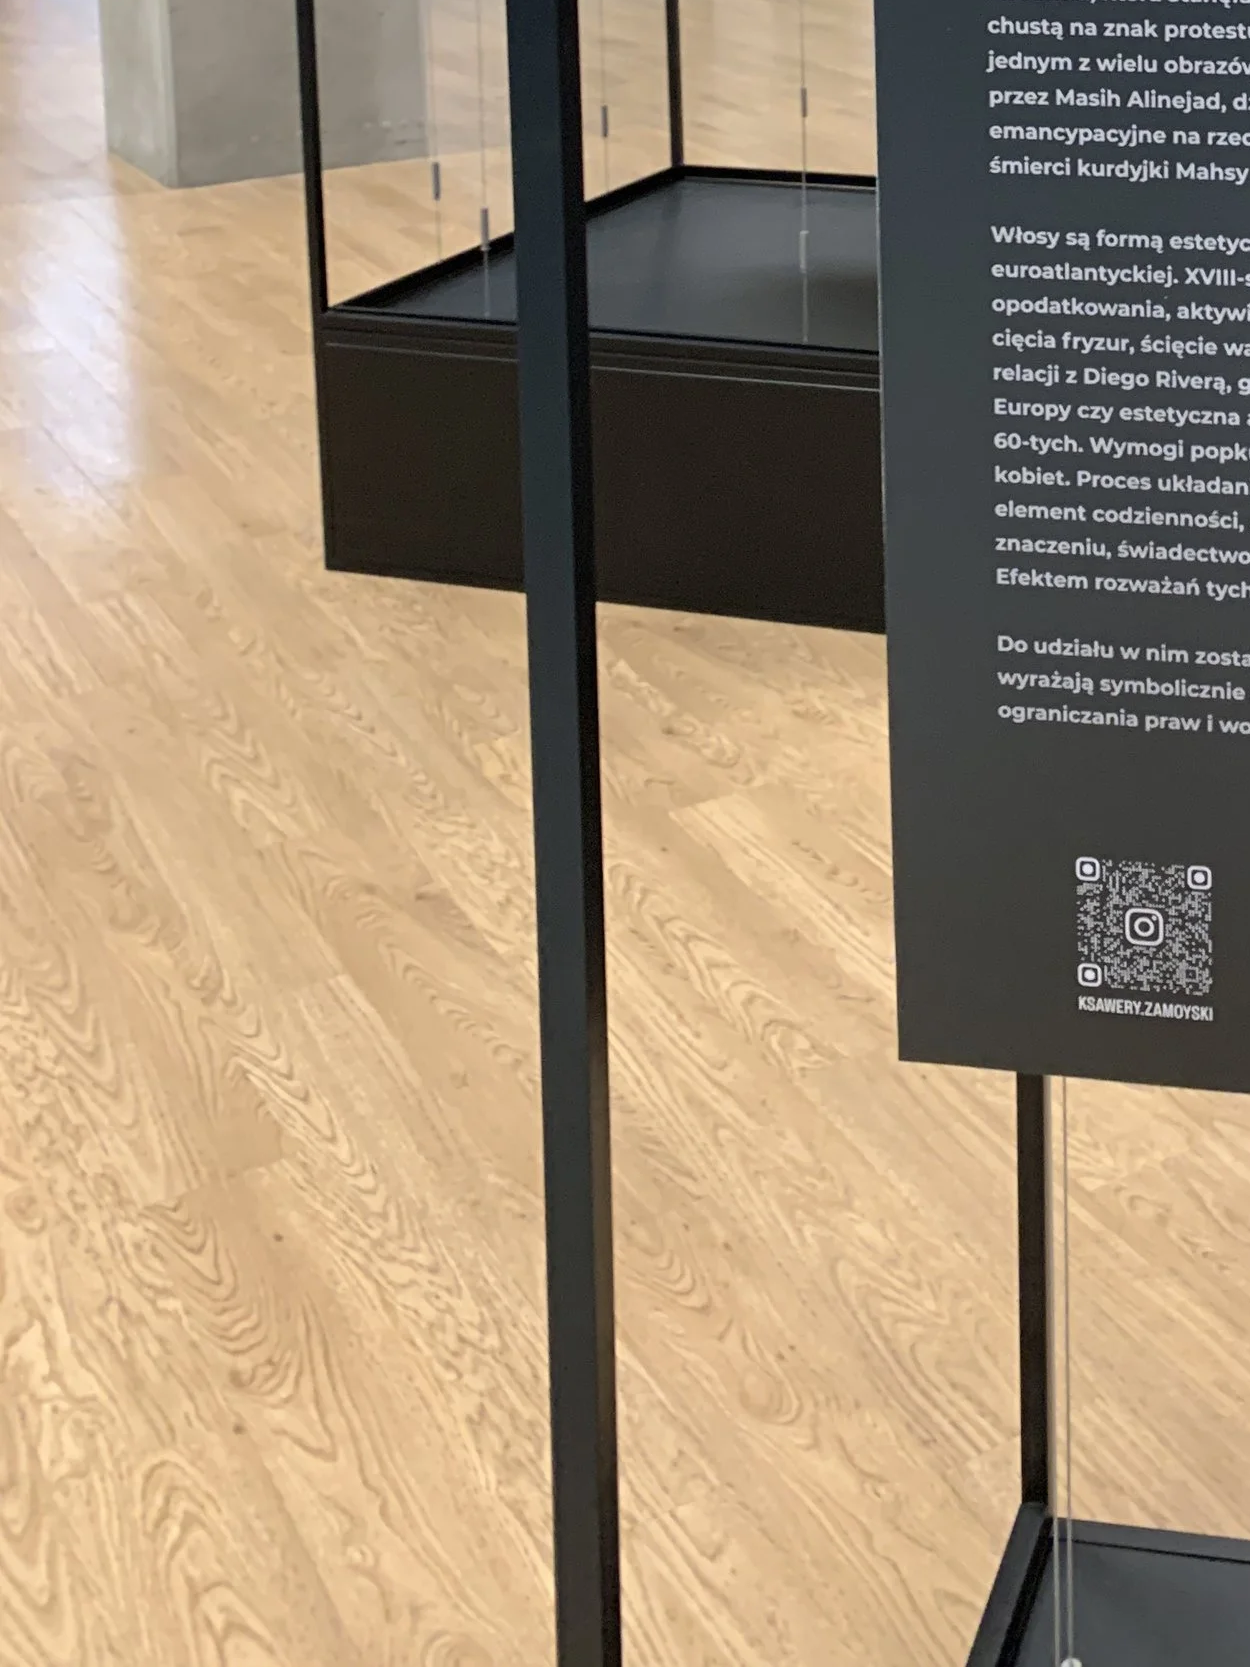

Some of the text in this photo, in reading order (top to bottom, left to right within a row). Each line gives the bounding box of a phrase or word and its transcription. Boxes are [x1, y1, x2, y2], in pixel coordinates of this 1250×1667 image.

[985, 49, 1073, 75] jednym
[1078, 56, 1092, 72] z
[1095, 52, 1158, 74] wielu
[988, 89, 1050, 109] przez
[1055, 87, 1121, 108] Masih
[1126, 88, 1228, 114] Alinejad,
[989, 155, 1071, 176] śmierci
[1077, 157, 1170, 183] kurdyjki
[1175, 161, 1250, 186] Mahsy
[990, 225, 1061, 250] Włosy
[1065, 231, 1091, 252] są
[1095, 228, 1164, 254] formą
[990, 261, 1180, 289] euroatlantyckiej.
[993, 397, 1072, 422] Europy
[1076, 405, 1115, 424] czy
[1118, 405, 1241, 428] estetyczna
[994, 464, 1071, 487] kobiet.
[1076, 469, 1153, 491] Proces
[996, 670, 1094, 696] wyrażają
[1099, 677, 1246, 701] symbolicznie
[997, 704, 1139, 728] ograniczania
[1144, 714, 1202, 732] praw
[1206, 713, 1214, 733] i
[1077, 994, 1215, 1022] KSAWERY.ZAMOYSKI
